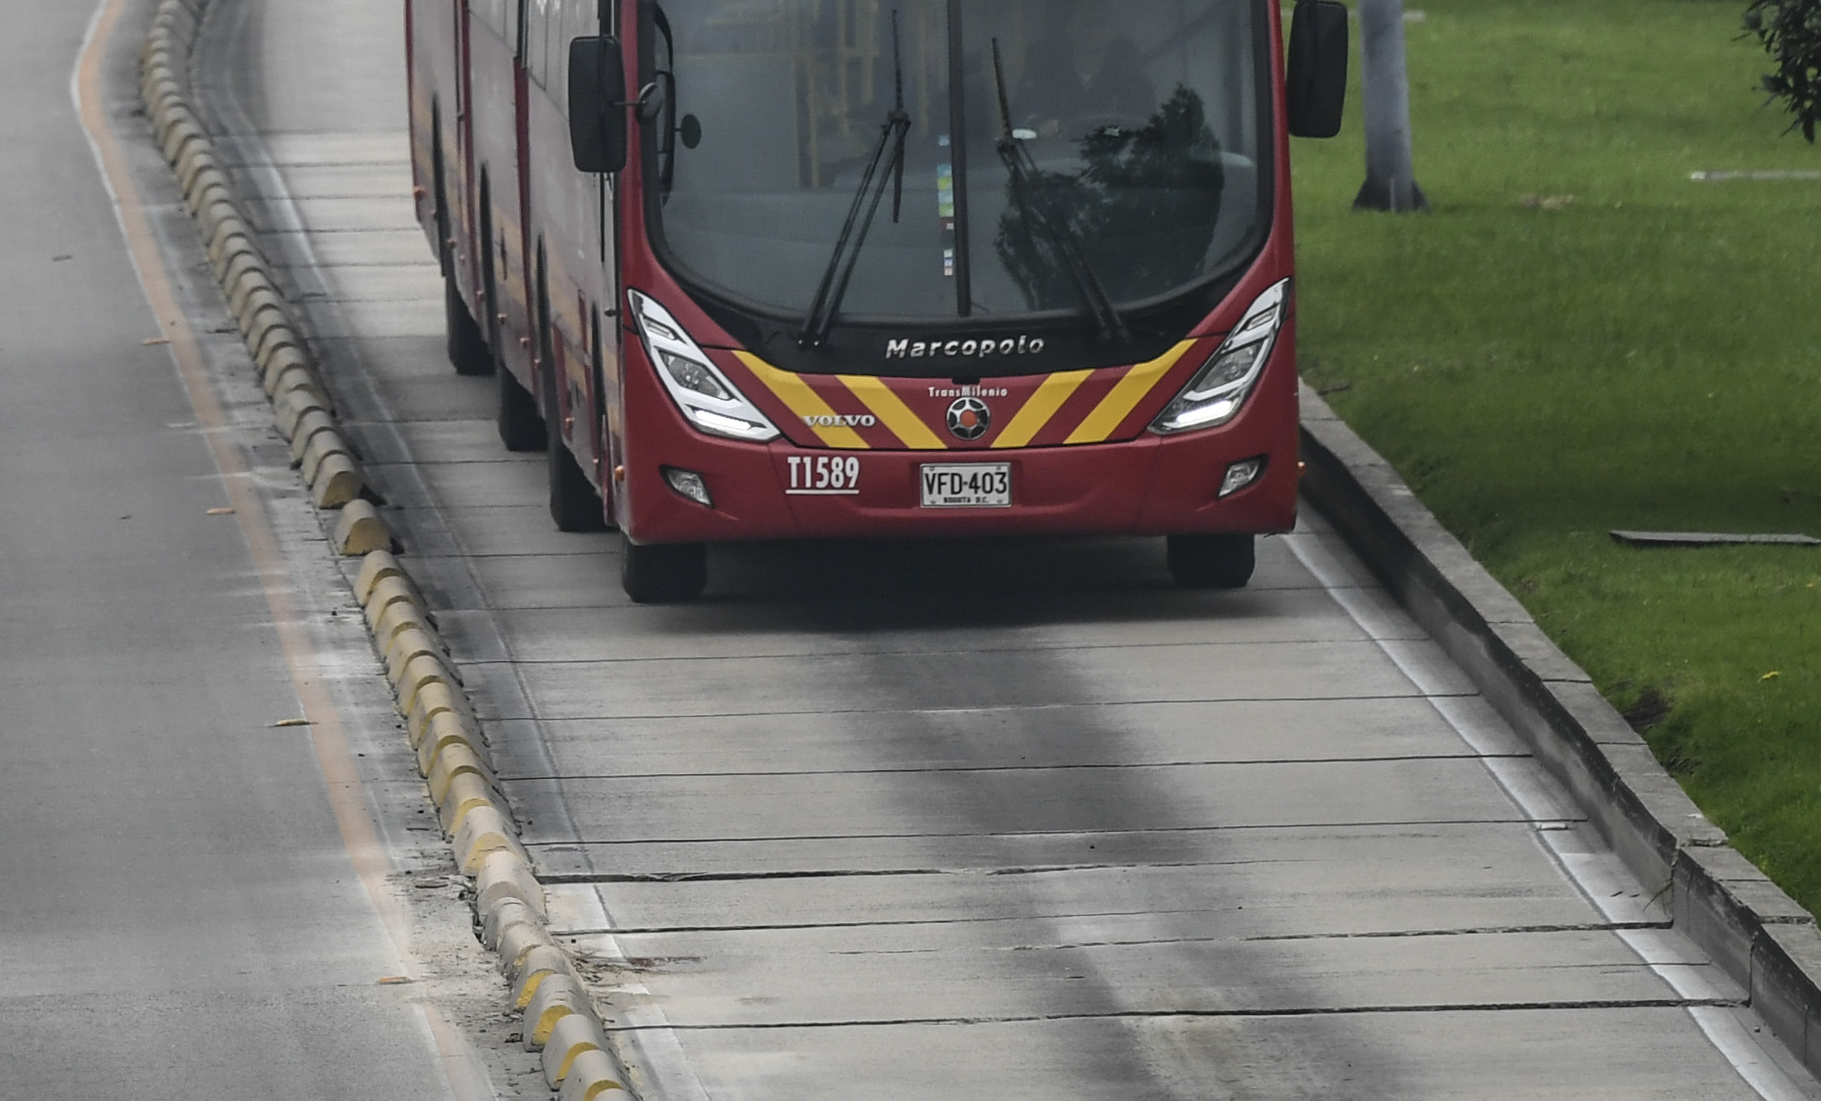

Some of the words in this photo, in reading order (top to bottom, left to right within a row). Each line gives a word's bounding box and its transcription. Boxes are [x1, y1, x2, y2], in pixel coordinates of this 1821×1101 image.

[885, 335, 1045, 359] Marcopolo
[928, 385, 1008, 398] TransMilenio
[802, 414, 876, 427] VOLVO
[787, 456, 860, 489] T1589
